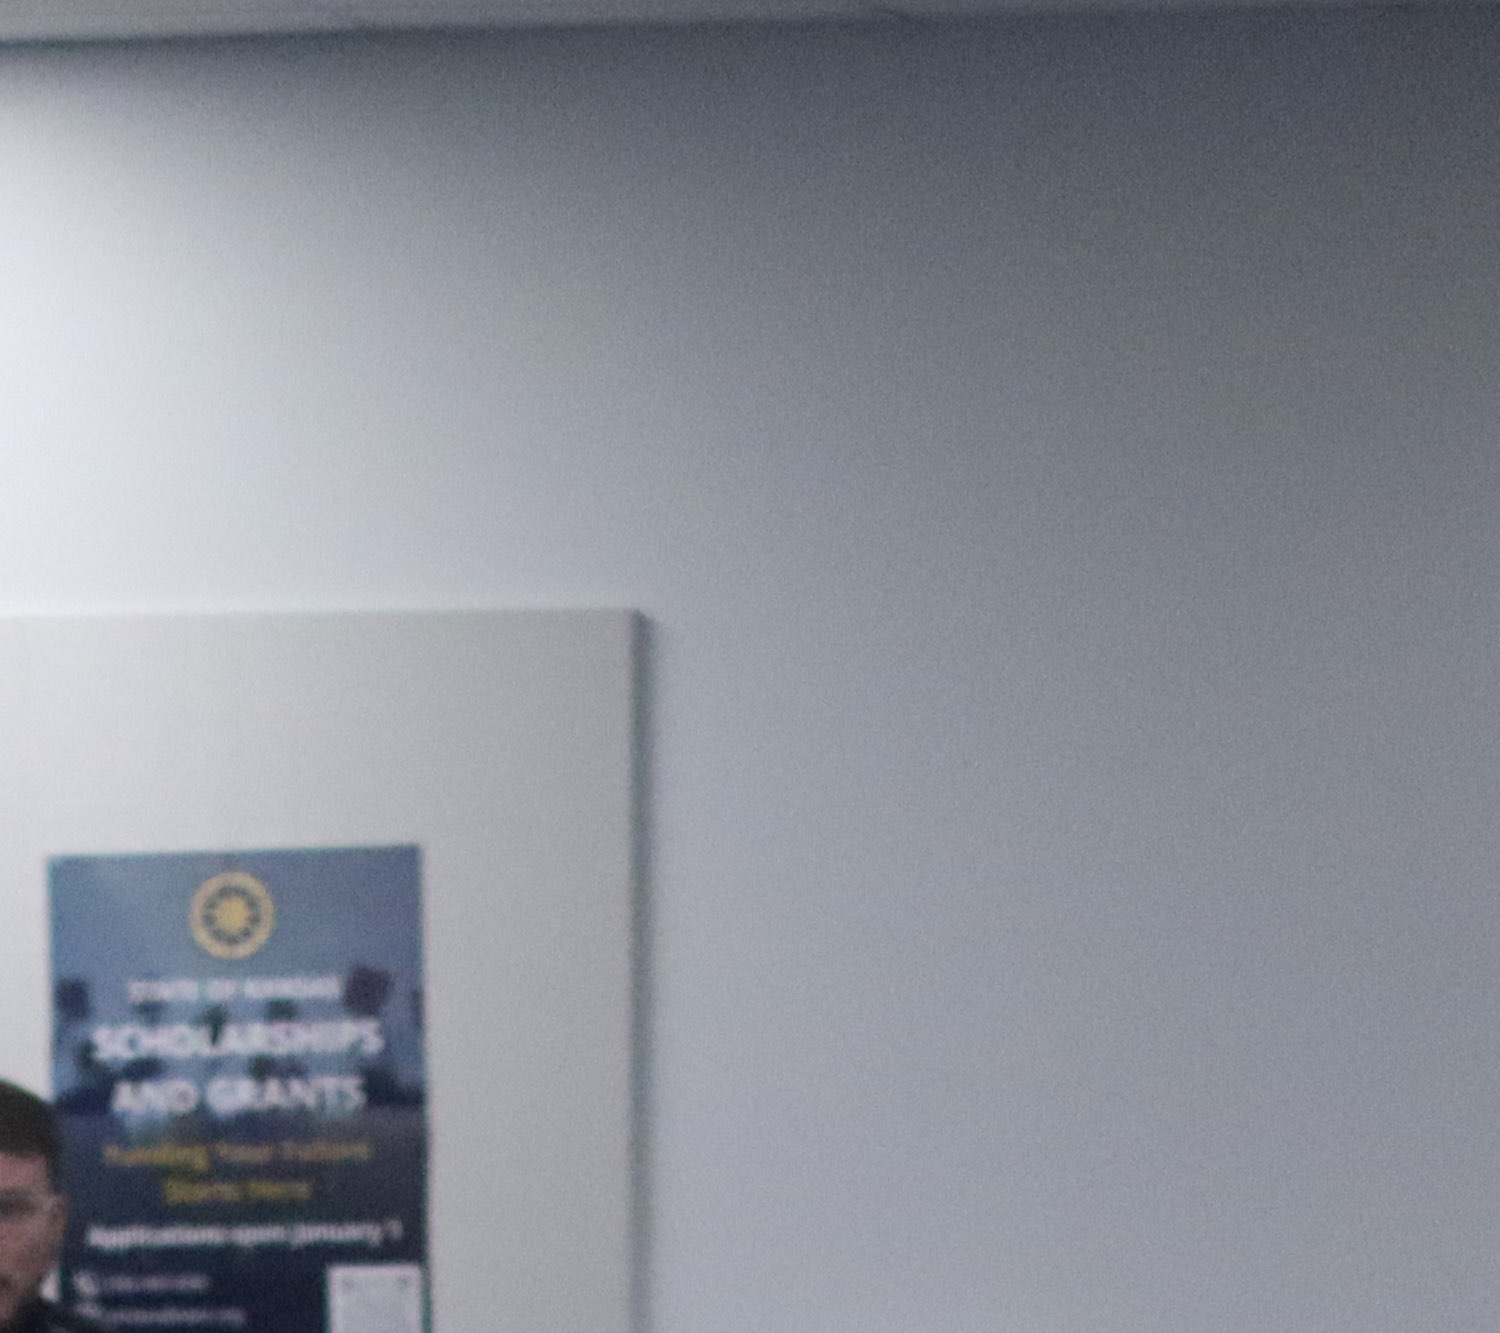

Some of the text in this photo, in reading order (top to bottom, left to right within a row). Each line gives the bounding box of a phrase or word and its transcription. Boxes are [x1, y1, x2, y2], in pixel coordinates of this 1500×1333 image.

[93, 1020, 386, 1060] SCHOLARSHIPS
[112, 1077, 366, 1113] AND GRANTS
